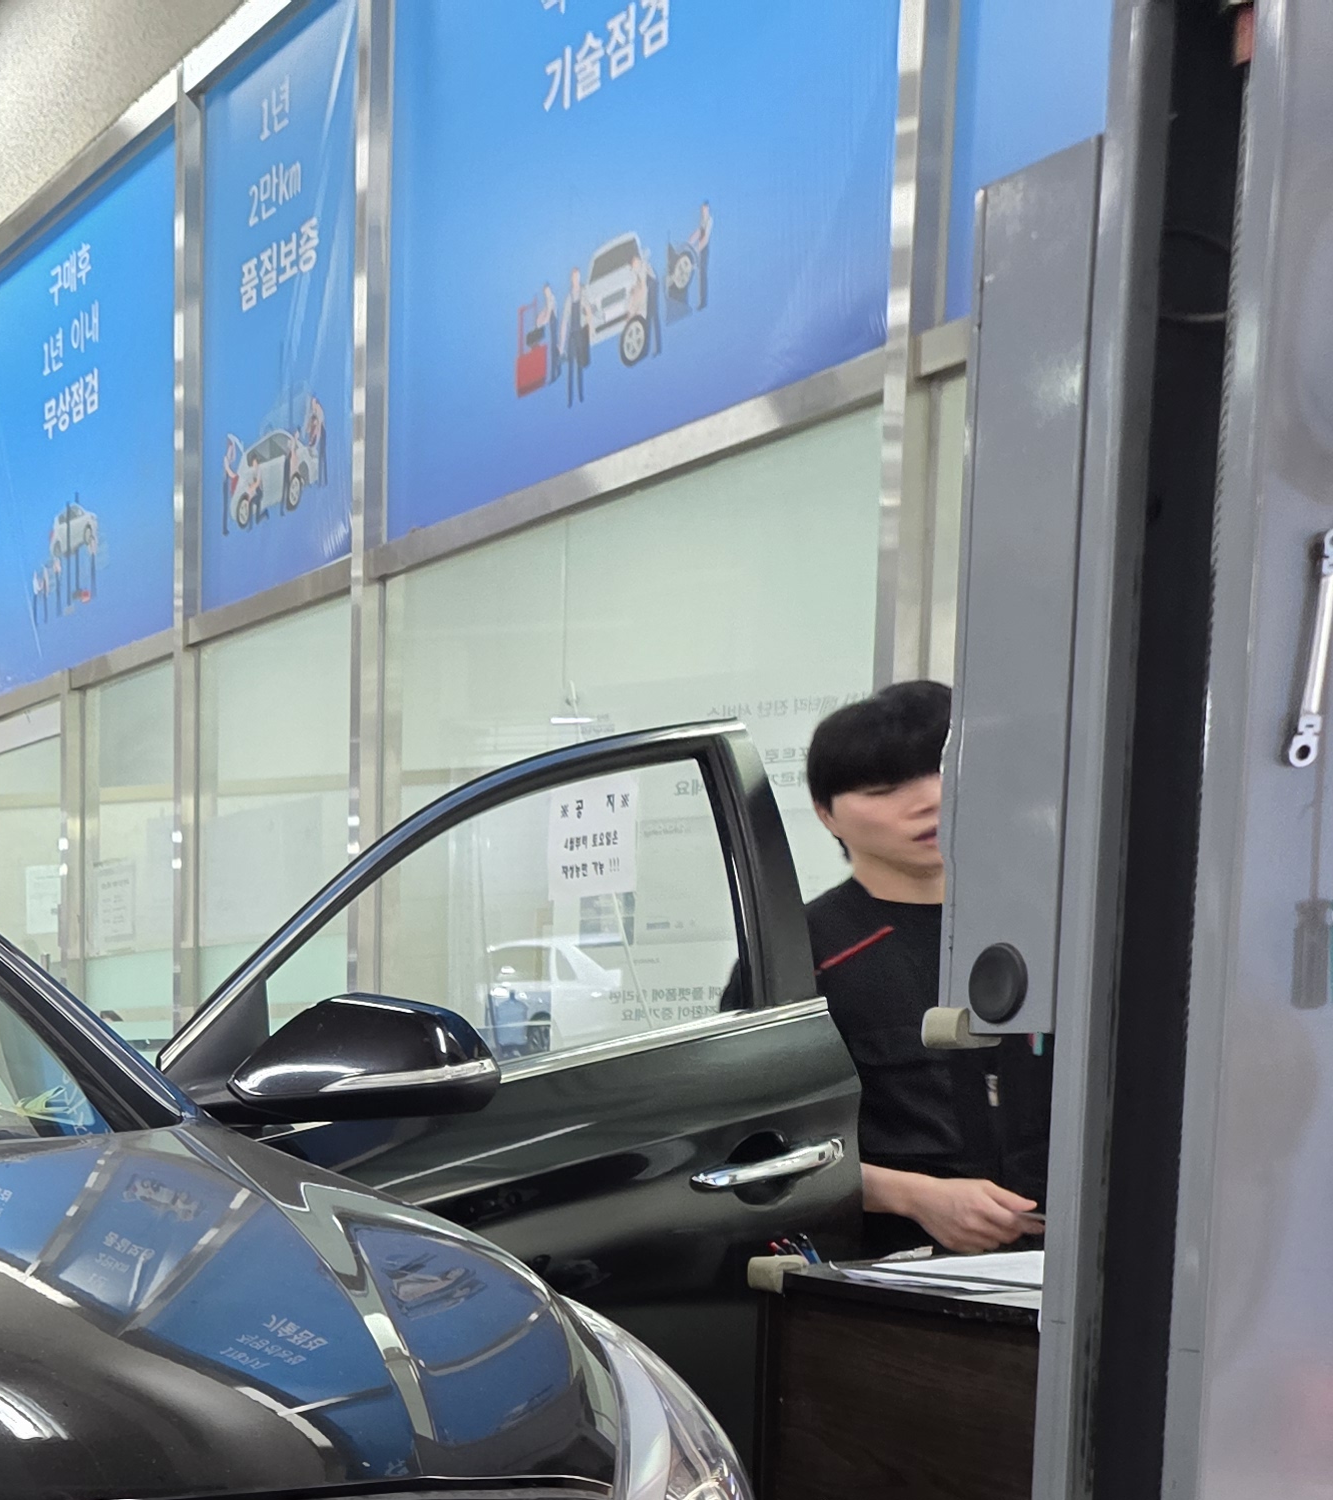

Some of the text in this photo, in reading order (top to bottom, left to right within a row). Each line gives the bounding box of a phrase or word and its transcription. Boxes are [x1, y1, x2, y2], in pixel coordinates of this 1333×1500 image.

[543, 0, 670, 112] 기술점검
[259, 75, 290, 141] 1년
[248, 160, 302, 227] 2만km
[49, 242, 92, 306] 구매후
[240, 216, 319, 312] 품질보증
[42, 300, 99, 376] 1년 이내
[43, 367, 99, 440] 무상점검
